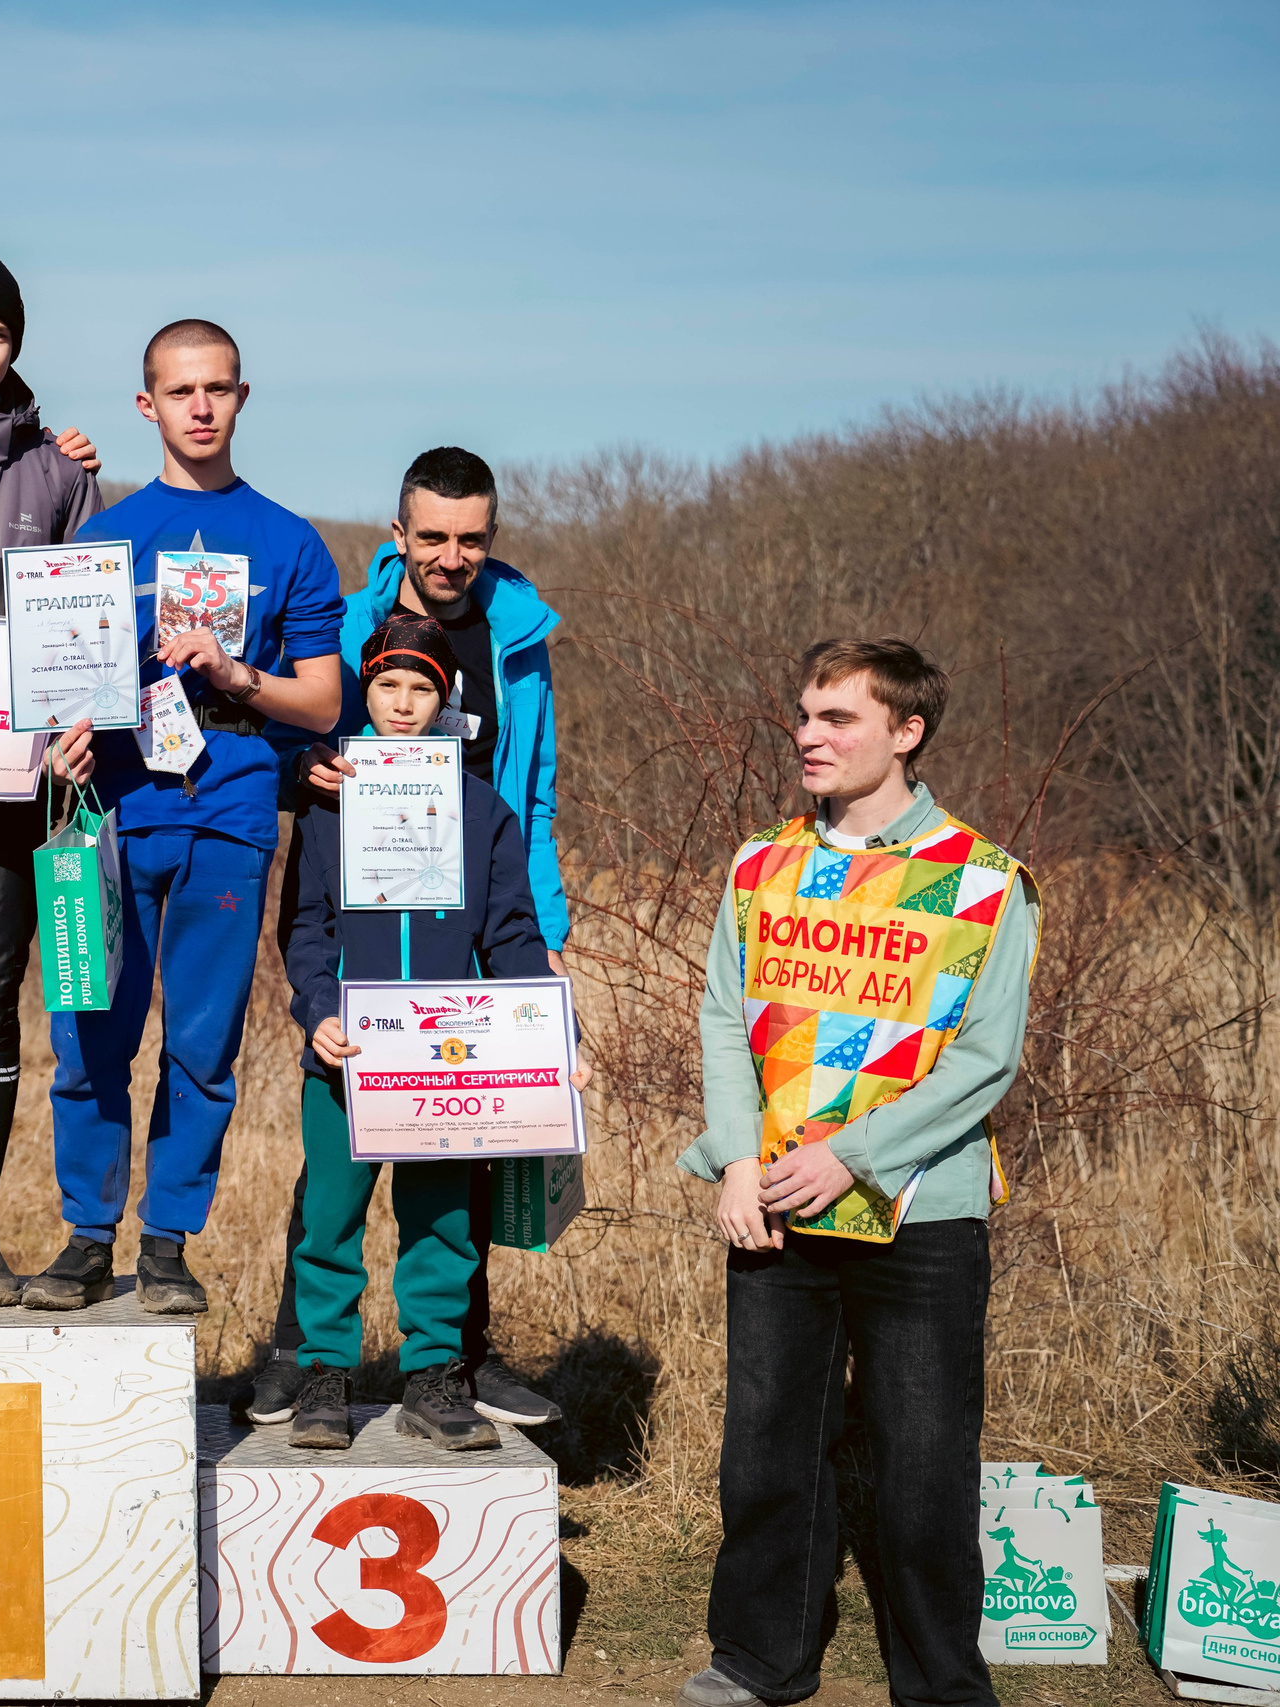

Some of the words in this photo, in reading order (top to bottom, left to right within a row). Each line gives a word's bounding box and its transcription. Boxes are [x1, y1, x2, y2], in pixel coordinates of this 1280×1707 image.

[8, 522, 42, 533] NORDSK
[180, 571, 227, 608] 55
[25, 594, 115, 612] ГРАМОТА
[31, 665, 63, 673] ЭСТАФЕТА
[64, 662, 102, 671] ПОКОЛЕНИЙ
[359, 783, 443, 796] ГРАМОТА
[759, 910, 928, 964] ВОЛОНТЁР
[53, 895, 73, 1006] ПОДПИШИСЬ
[74, 896, 93, 1006] PUBLIC_BIONOVA
[752, 955, 852, 997] ДОБРЫХ
[858, 971, 913, 1007] ДЕЛ
[409, 1000, 461, 1015] Эстафета
[359, 1015, 405, 1031] O-TRAIL
[363, 1073, 456, 1089] ПОДАРОЧНЫЙ
[462, 1071, 556, 1086] СЕРТИФИКАТ
[412, 1098, 426, 1117] 7
[503, 1158, 515, 1243] ПОДПИШИС
[311, 1493, 448, 1664] 3
[1010, 1632, 1036, 1643] ДНЯ
[1039, 1631, 1088, 1641] ОСНОВА
[1207, 1641, 1237, 1656] ДНЯ
[1240, 1647, 1280, 1664] ОСНО
